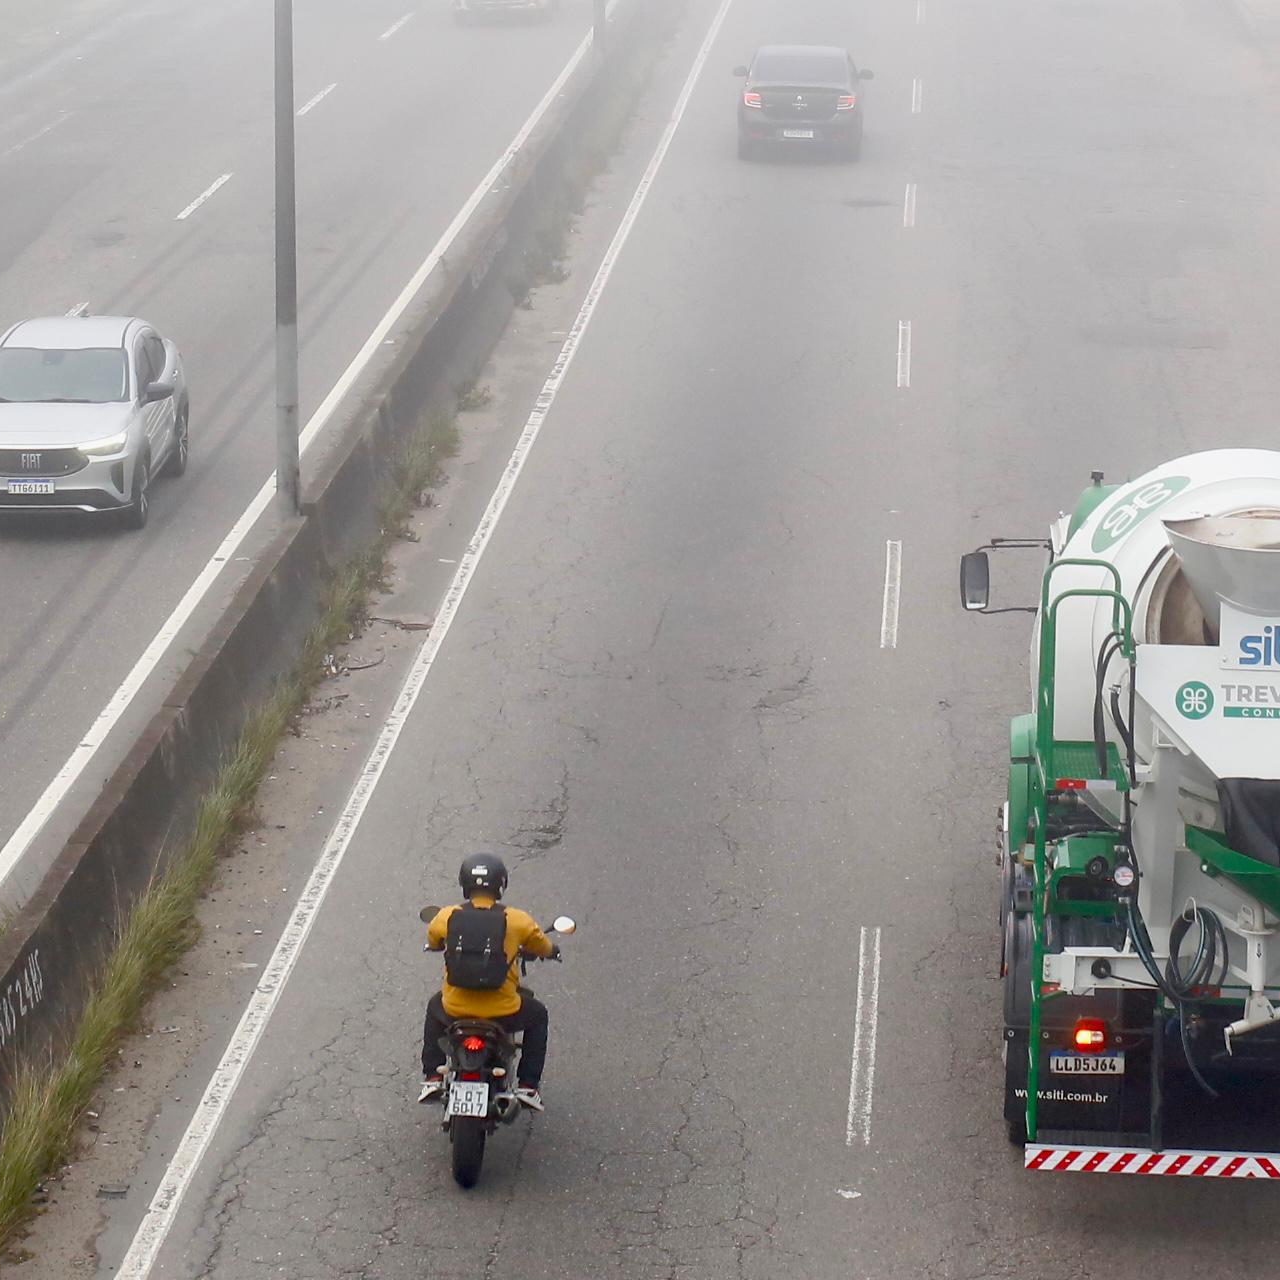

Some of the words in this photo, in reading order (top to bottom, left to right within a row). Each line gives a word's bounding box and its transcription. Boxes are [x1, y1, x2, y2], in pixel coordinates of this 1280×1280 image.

[21, 453, 41, 470] FIAT
[1055, 1057, 1117, 1072] LLD5J64
[1014, 1088, 1109, 1103] ww.siti.com.br
[452, 1101, 484, 1115] 6017
